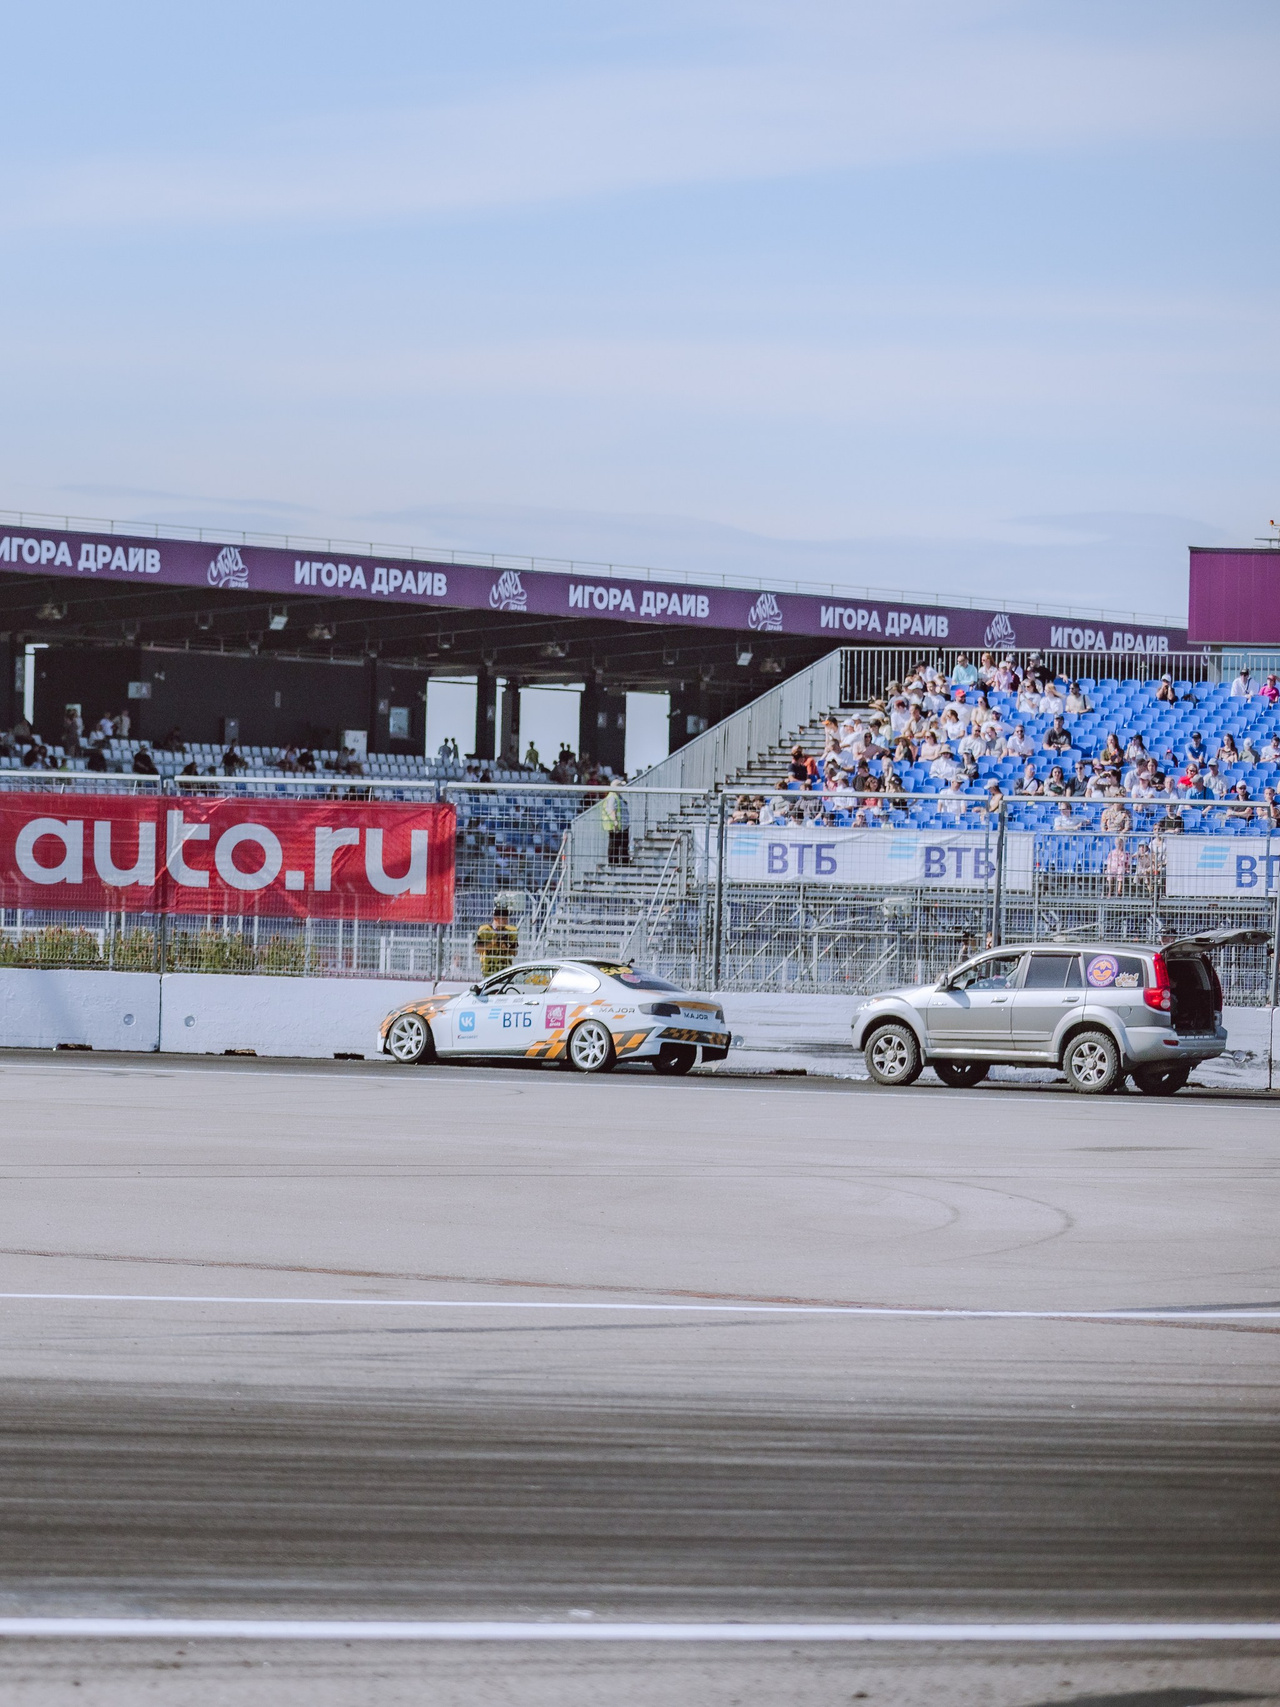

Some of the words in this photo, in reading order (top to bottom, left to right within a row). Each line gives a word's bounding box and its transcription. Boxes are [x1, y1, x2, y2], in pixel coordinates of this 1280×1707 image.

[77, 543, 161, 574] ДРАЙВ
[294, 560, 367, 590] ИГОРА
[370, 567, 448, 597] ДРАЙВ
[568, 584, 636, 613] ИГОРА
[639, 590, 710, 619] ДРАЙВ
[821, 605, 882, 633] ИГОРА
[884, 611, 949, 638] ДРАЙВ
[1050, 625, 1107, 652] ИГОРА
[1109, 631, 1170, 653] ДРАЙВ
[15, 810, 429, 896] auto.ru
[767, 842, 838, 876] ВТБ
[924, 846, 997, 879] ВТБ
[502, 1011, 533, 1028] ВТБ
